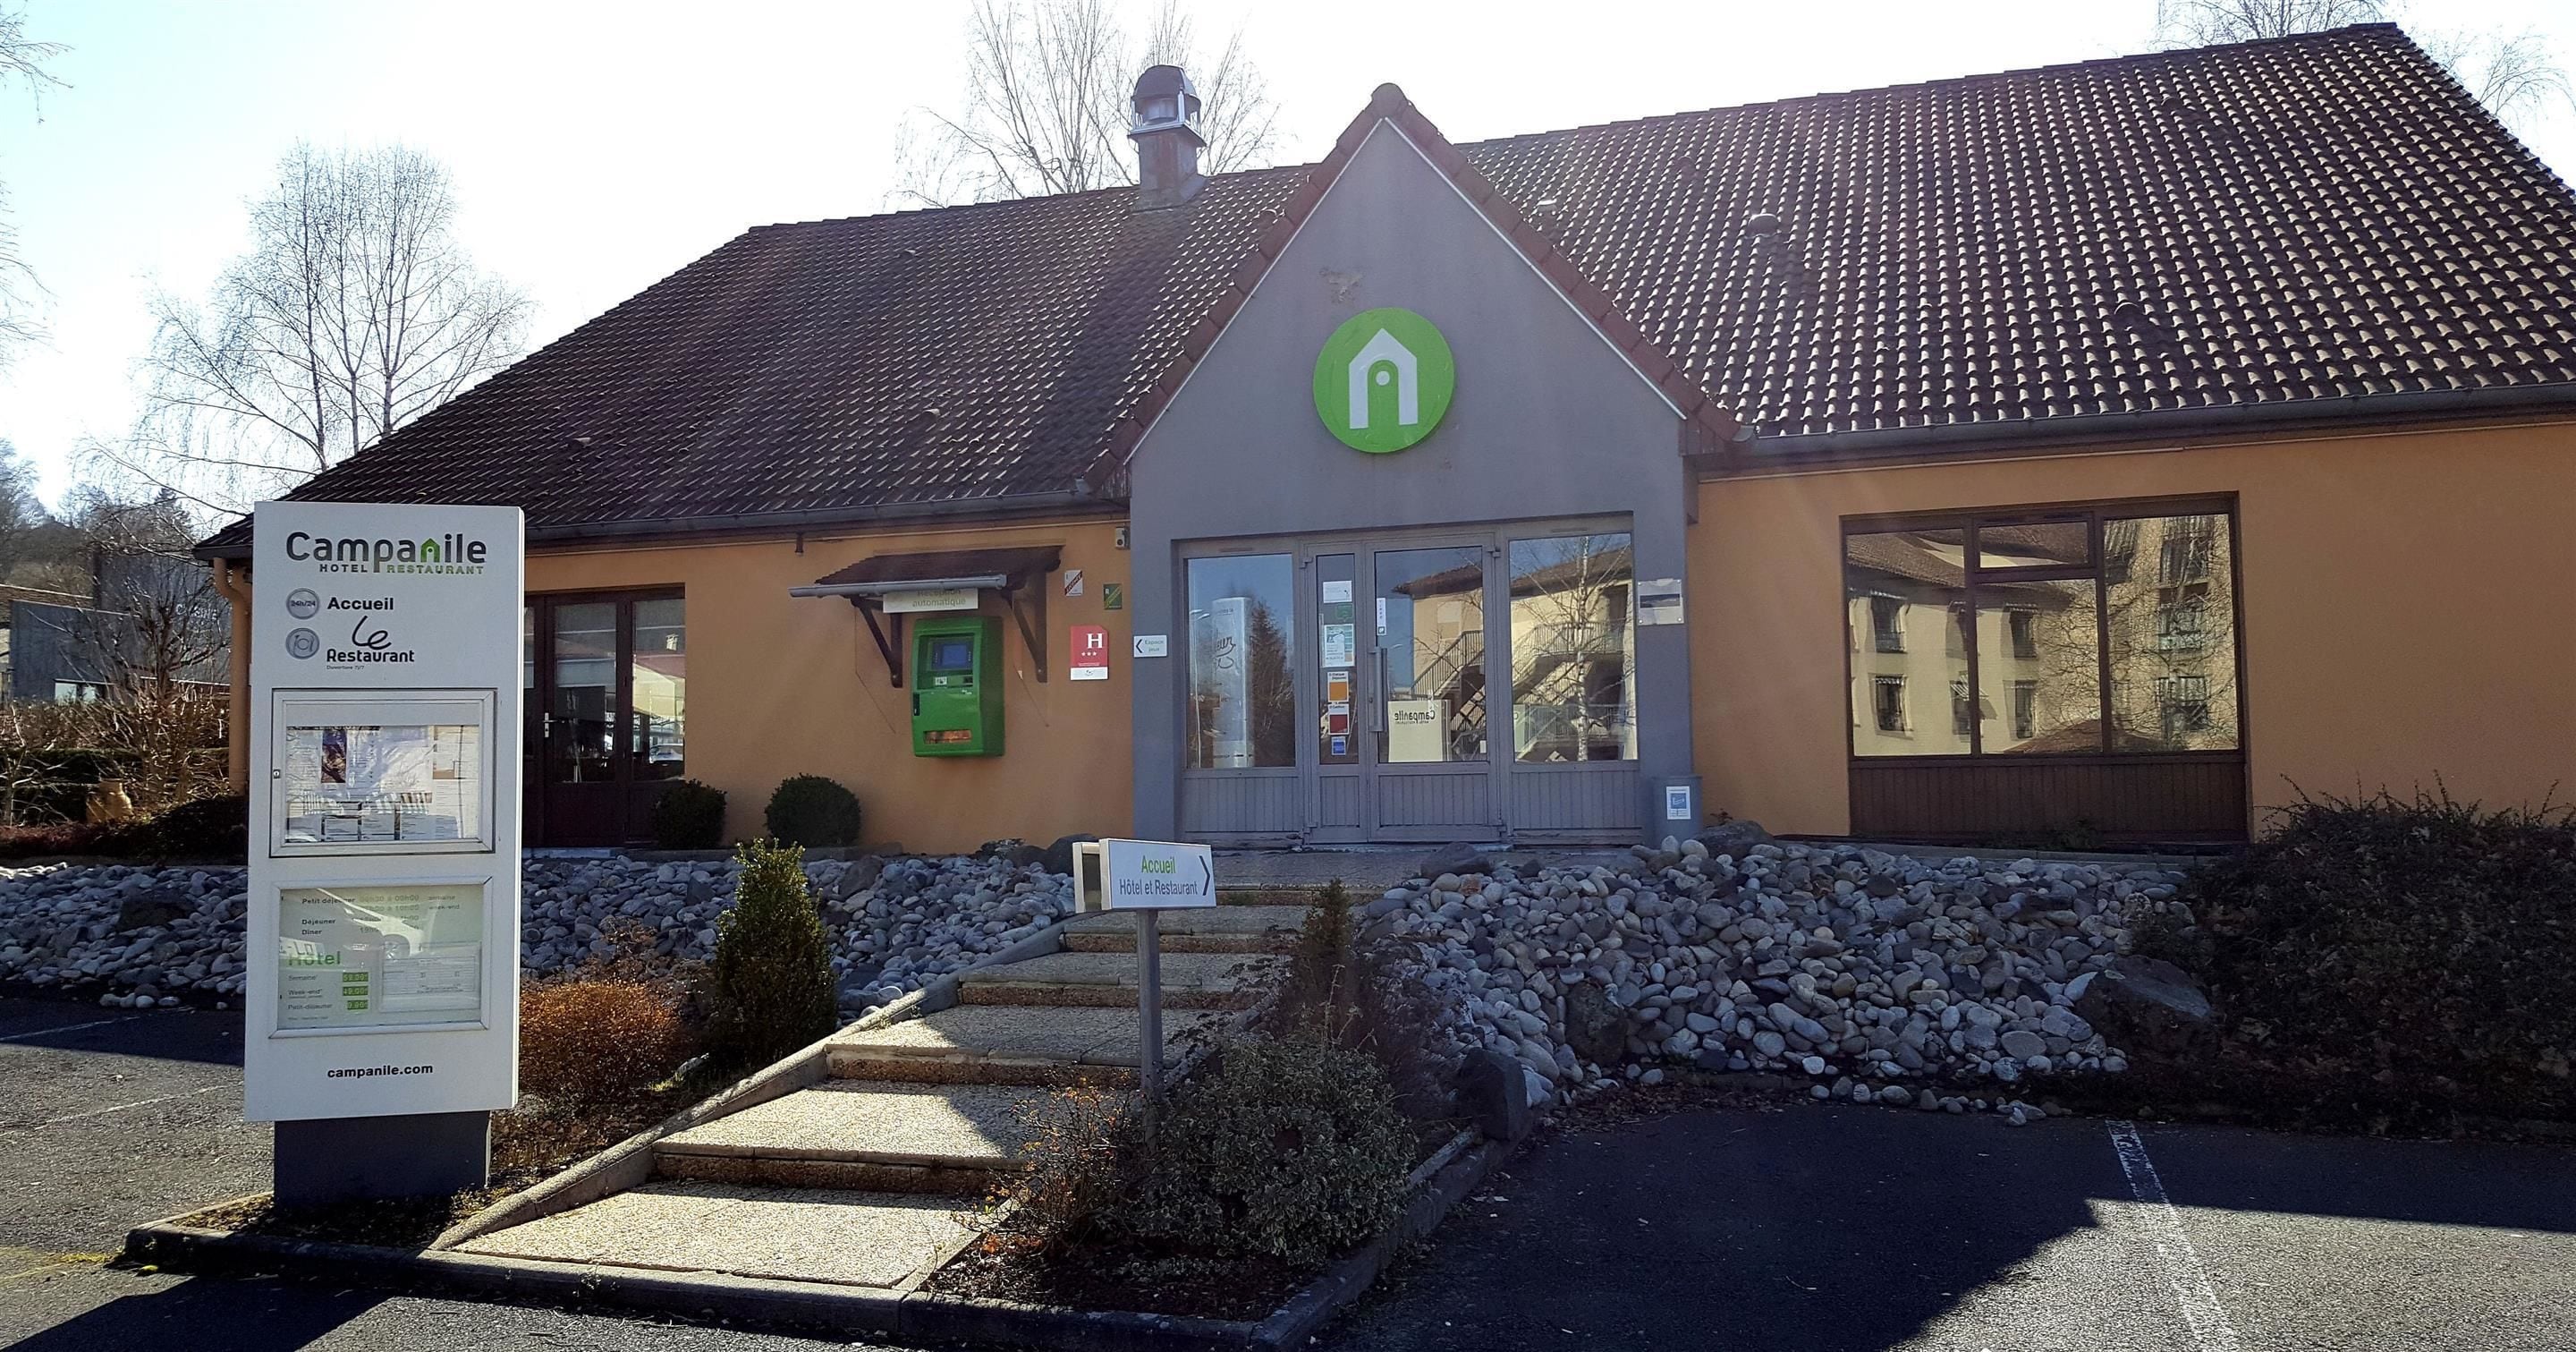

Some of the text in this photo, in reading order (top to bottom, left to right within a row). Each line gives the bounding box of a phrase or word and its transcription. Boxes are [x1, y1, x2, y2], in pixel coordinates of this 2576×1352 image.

[286, 531, 487, 573] Campanile
[319, 564, 484, 574] HOTEL RESTAURANT
[326, 597, 394, 610] Accueil
[912, 598, 966, 607] automatique
[1088, 633, 1103, 649] H
[326, 649, 415, 662] Restaurant
[1141, 855, 1175, 874] Accueil
[1119, 879, 1198, 896] Hôtel et Restaurant
[327, 1064, 433, 1079] campanile.com
